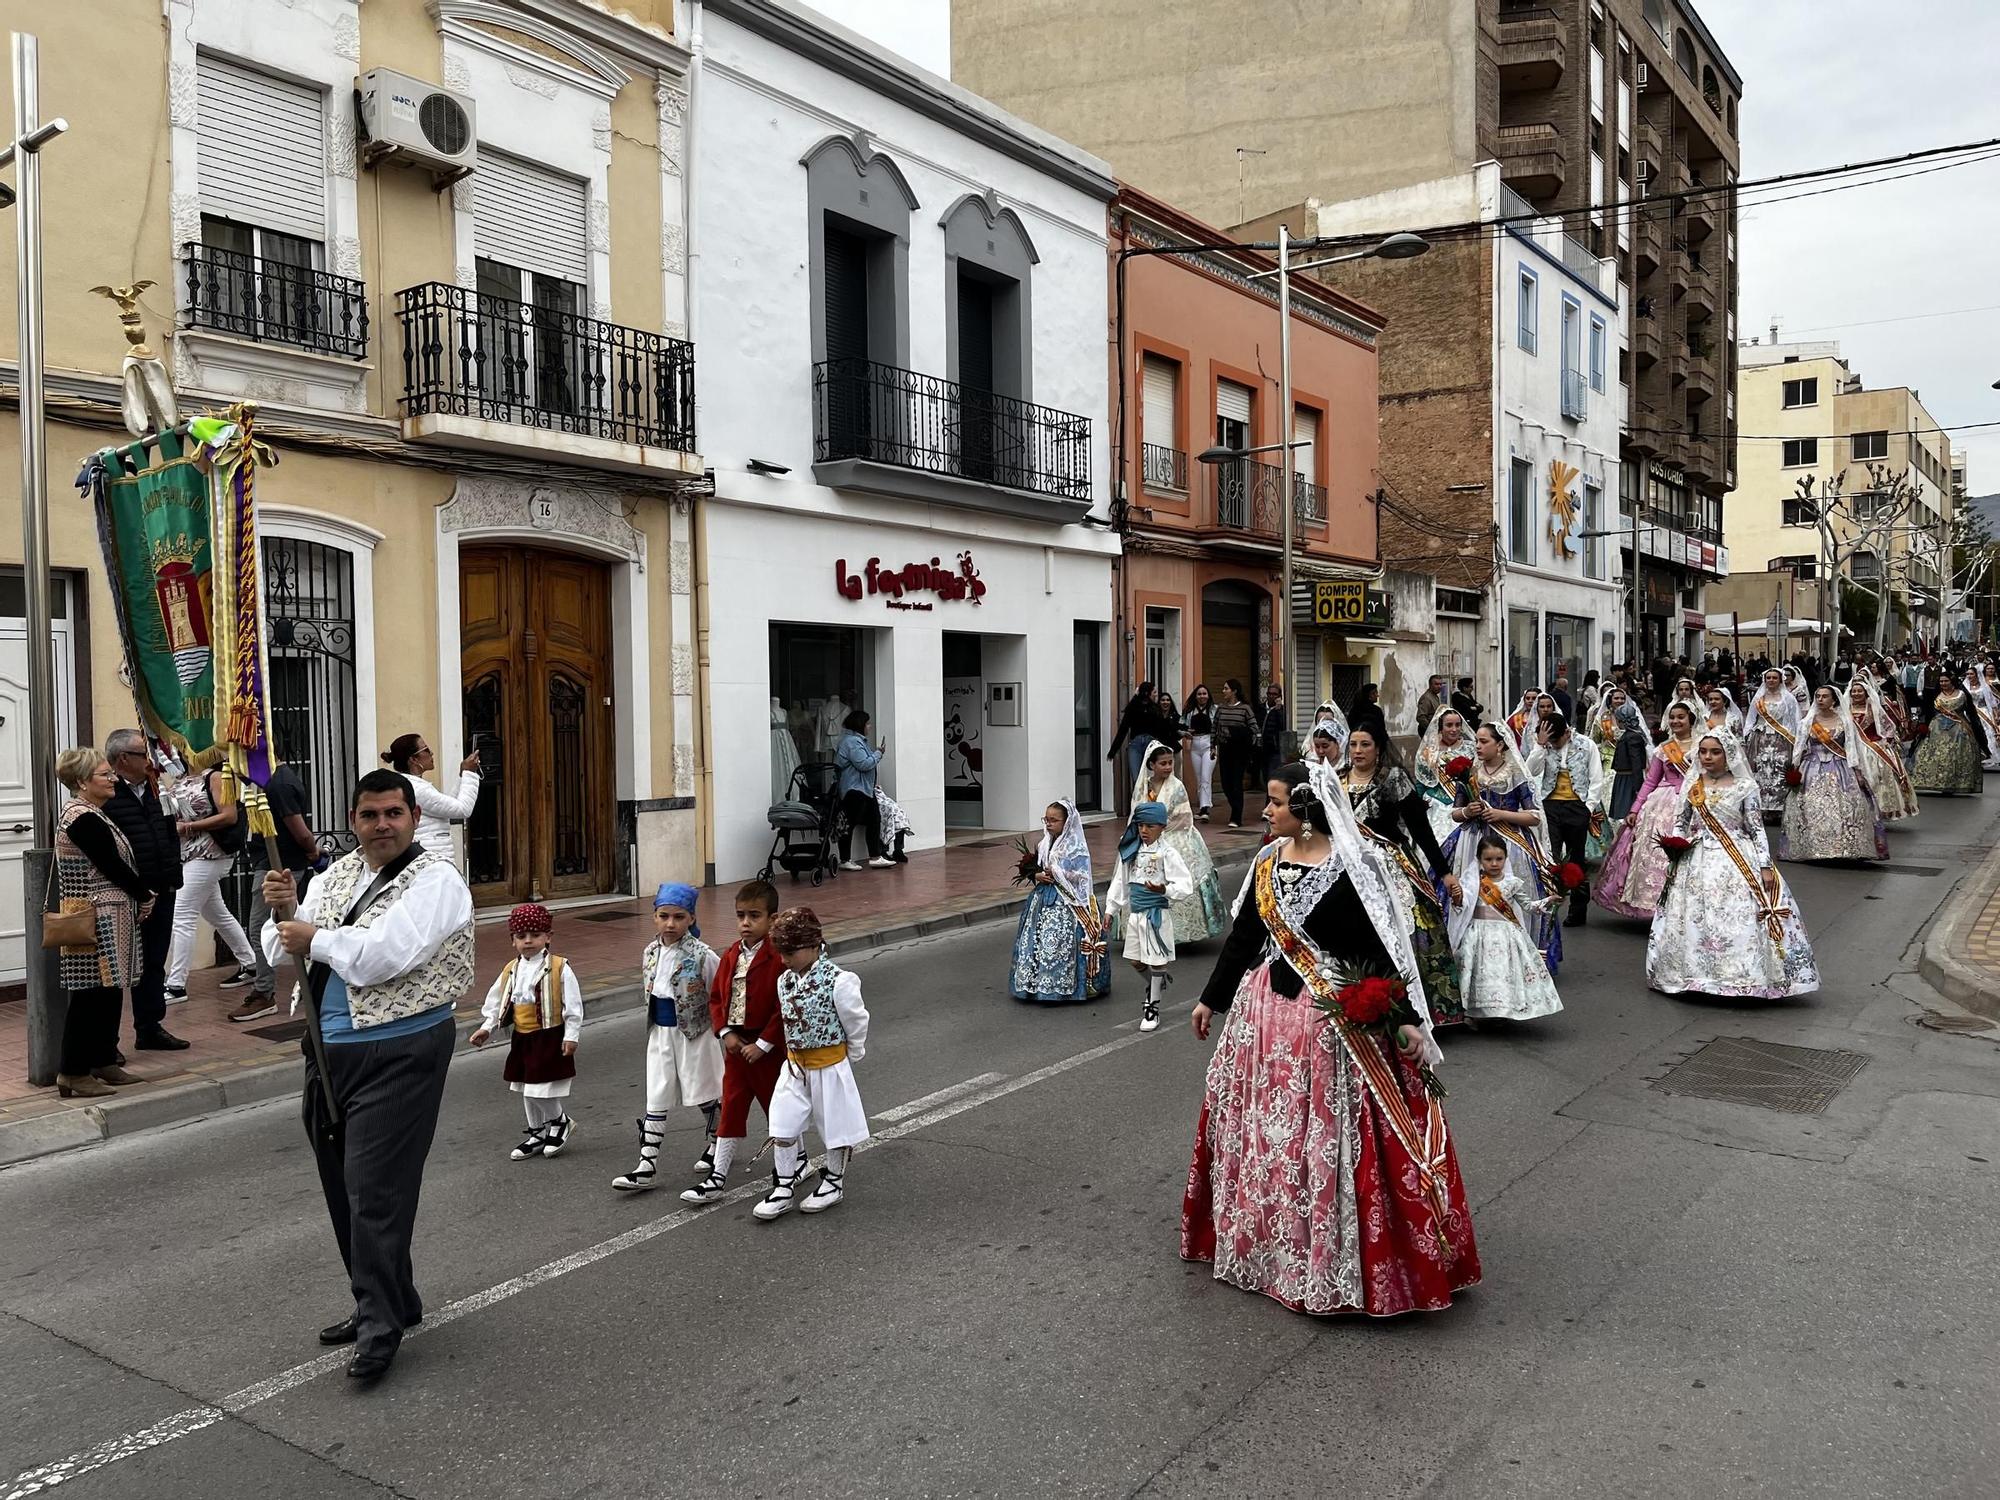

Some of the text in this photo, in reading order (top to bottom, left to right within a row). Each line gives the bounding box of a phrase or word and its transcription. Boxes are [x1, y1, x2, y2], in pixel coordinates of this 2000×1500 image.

[540, 503, 551, 516] 16
[835, 557, 966, 600] la formiga
[1319, 585, 1361, 597] COMPRO
[1319, 598, 1361, 619] ORO
